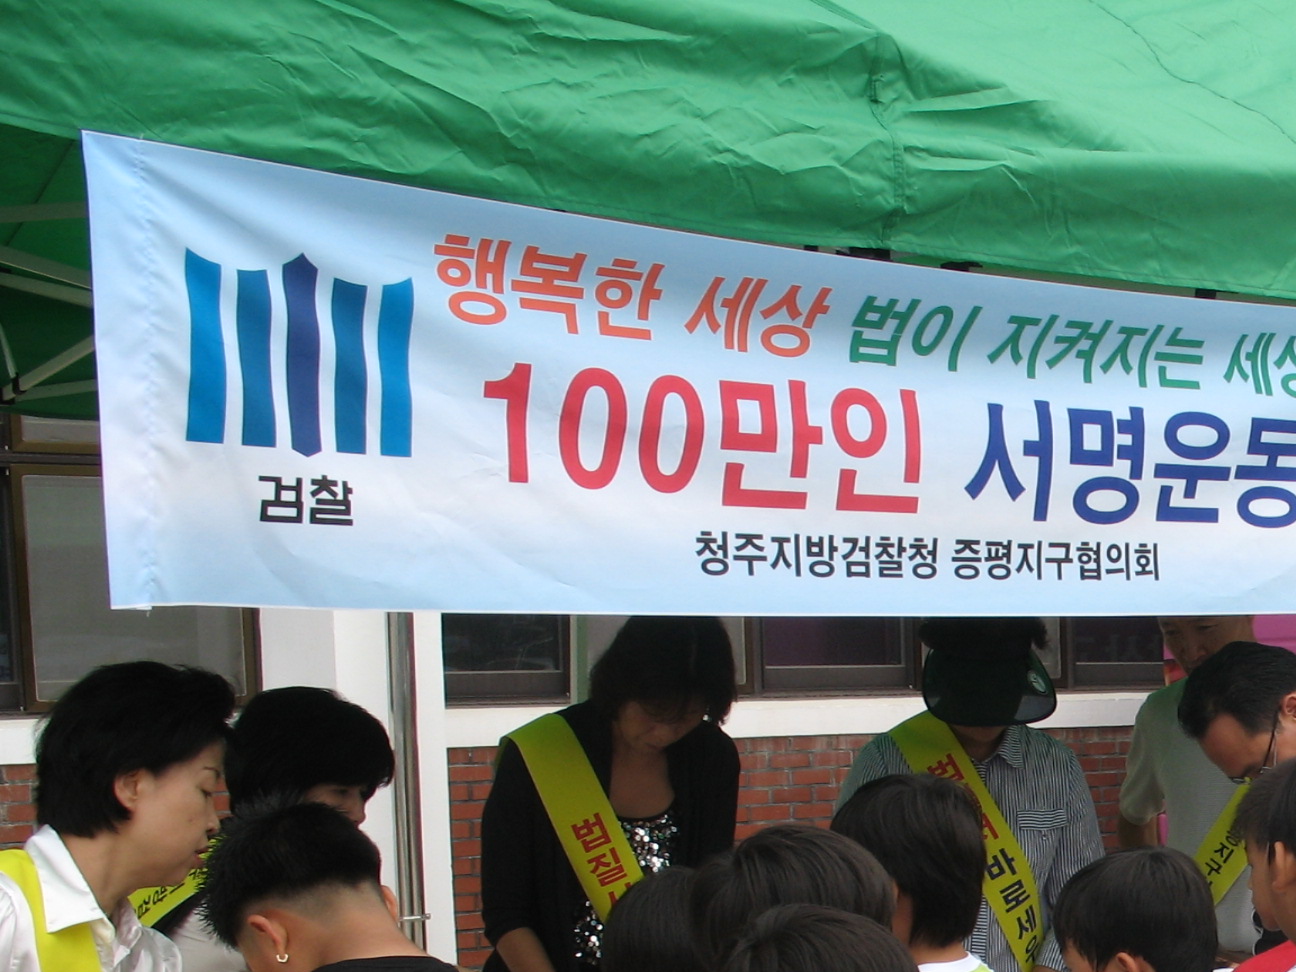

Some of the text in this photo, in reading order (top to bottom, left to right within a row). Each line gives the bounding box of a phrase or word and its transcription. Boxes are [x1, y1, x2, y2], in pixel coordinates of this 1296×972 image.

[434, 234, 664, 341] 행복한
[685, 277, 830, 358] 세상
[849, 295, 983, 372] 법이
[987, 314, 1205, 391] 지켜지는
[483, 362, 921, 514] 100만인
[258, 475, 354, 527] 검찰
[695, 530, 1160, 581] 청주지방검찰청 증평지구협의회
